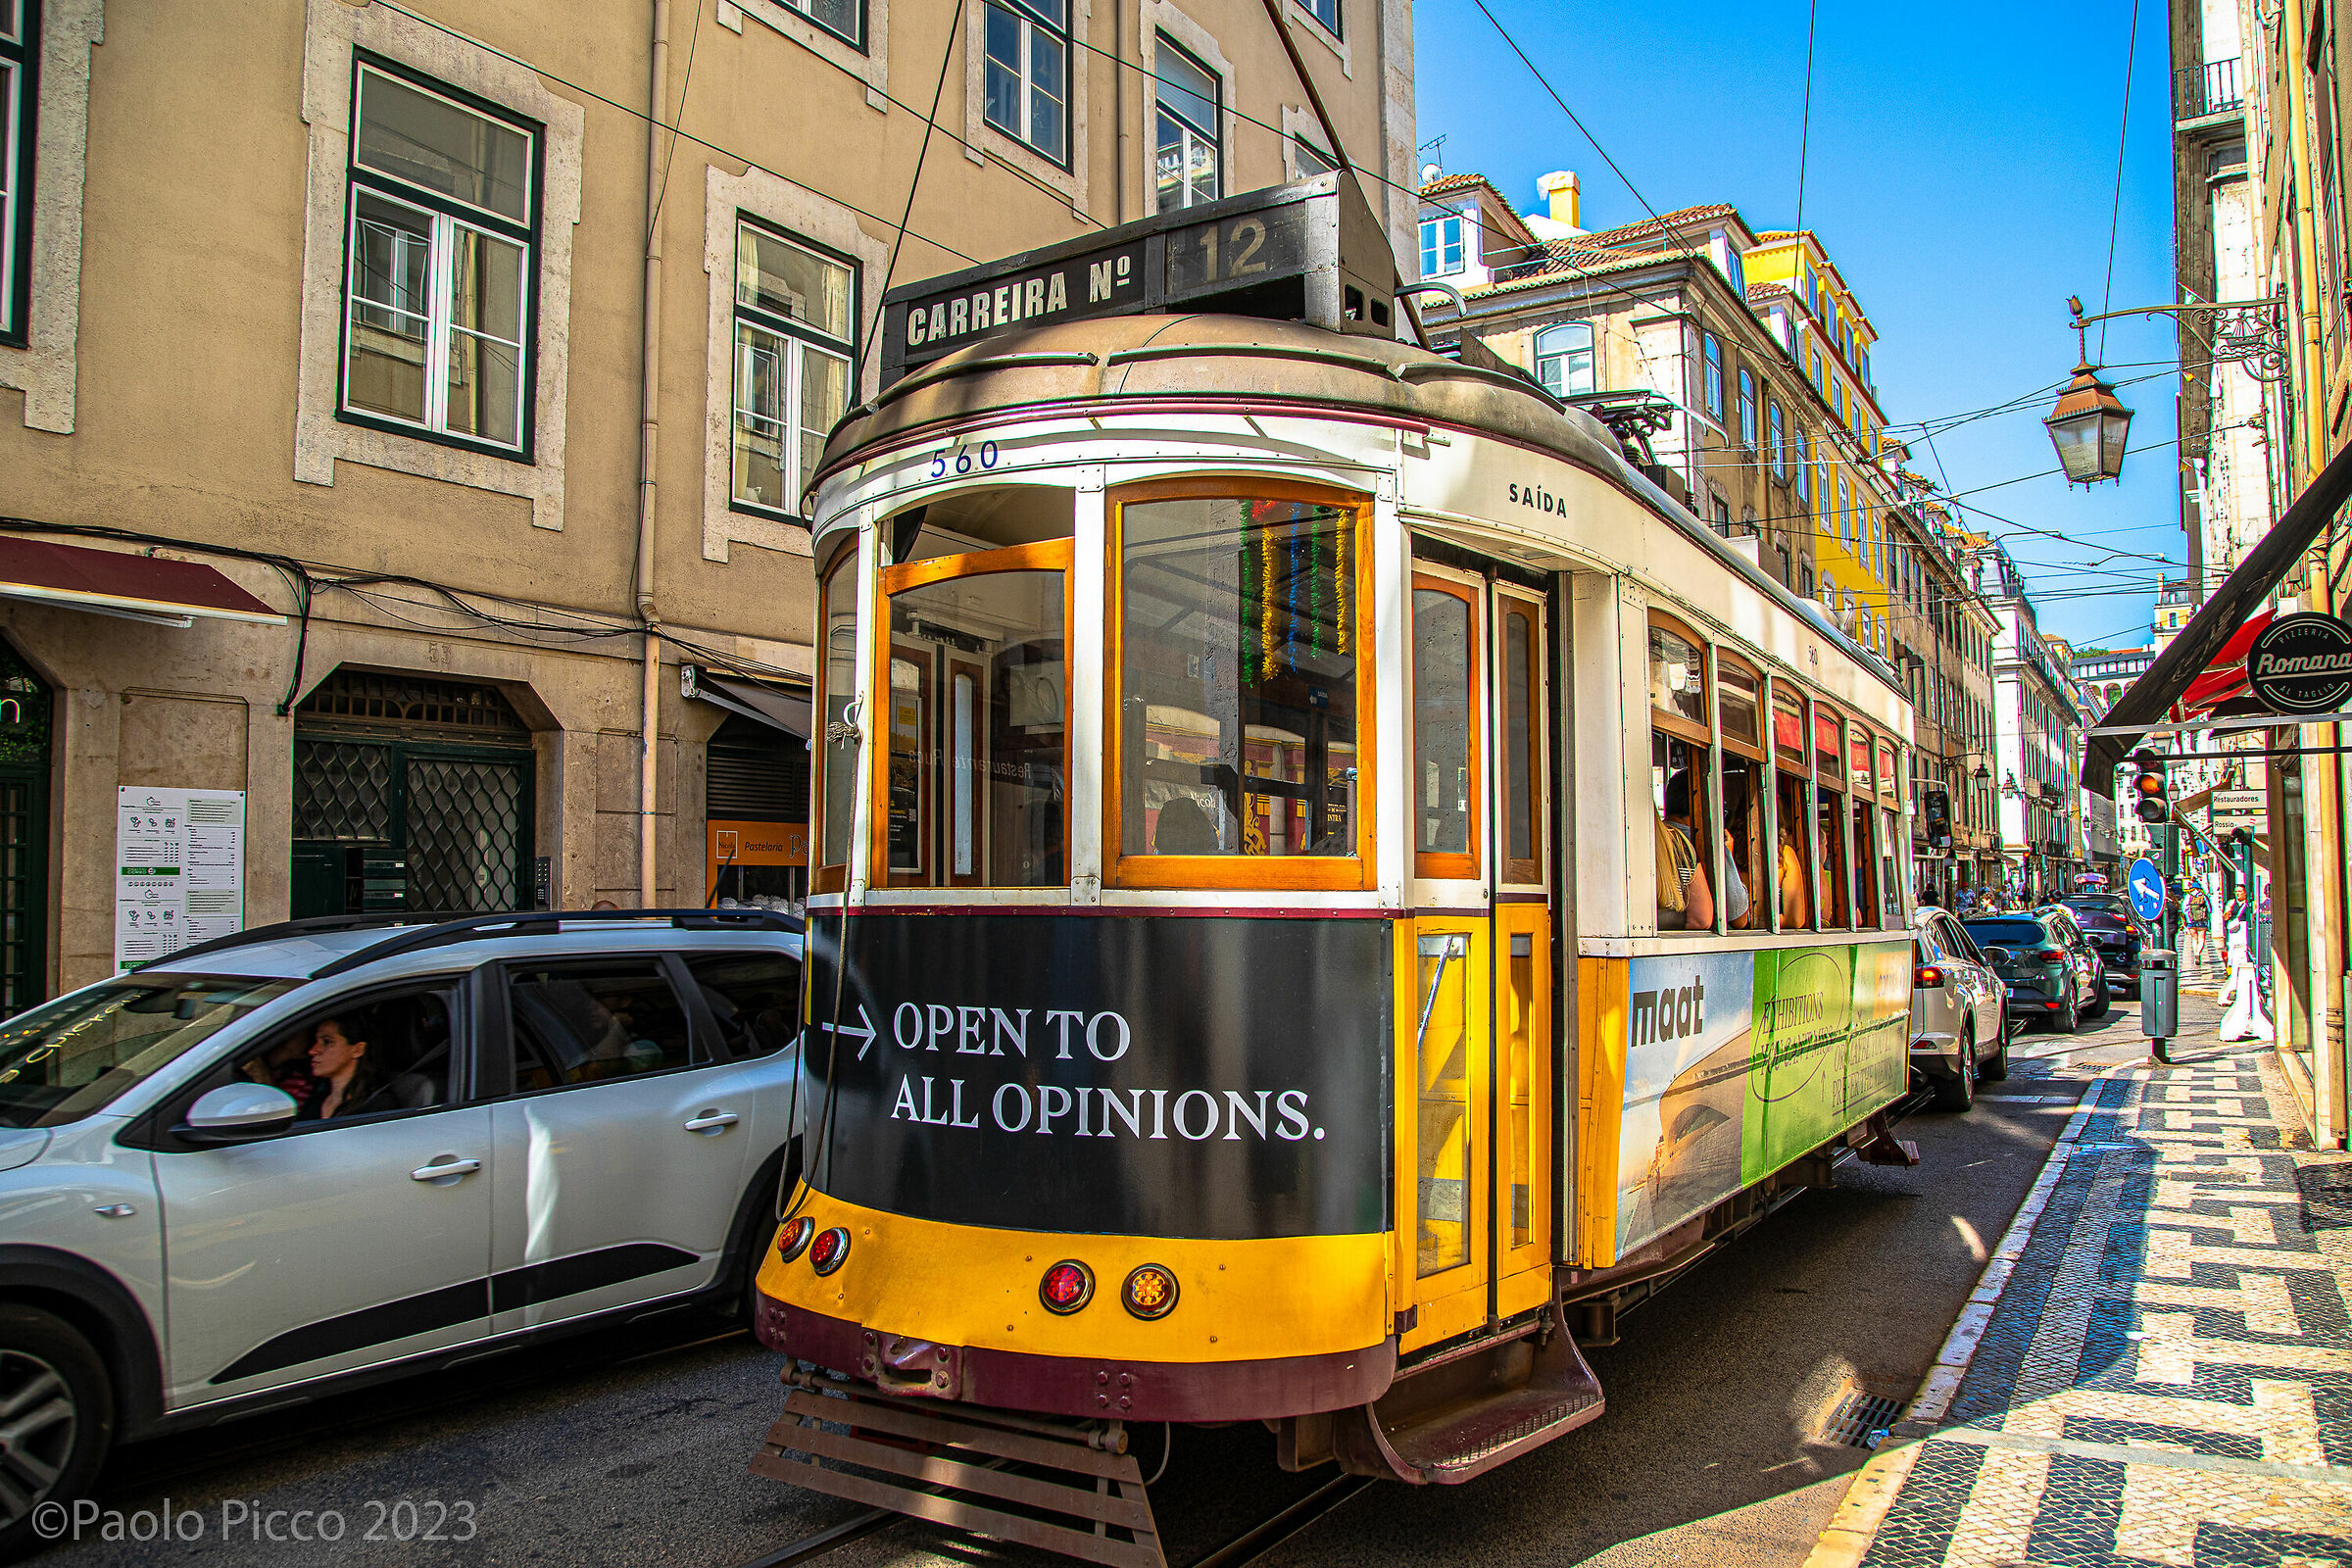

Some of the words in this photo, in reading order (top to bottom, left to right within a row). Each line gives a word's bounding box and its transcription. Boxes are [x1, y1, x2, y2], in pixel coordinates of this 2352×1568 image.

[1199, 217, 1267, 283] 12
[906, 270, 1067, 347] CARREIRA
[1088, 255, 1132, 304] Nº
[930, 440, 999, 479] 560
[1508, 482, 1568, 518] SAÍDA
[428, 642, 452, 665] 53
[2278, 628, 2329, 644] PIZZERIA
[2256, 652, 2352, 675] Romana
[2279, 685, 2291, 696] AL
[2297, 683, 2334, 698] TAGLIO
[744, 840, 783, 852] Pastelaria
[1631, 974, 1704, 1048] maat
[1762, 991, 1824, 1035] EXHIBITIONS
[893, 1002, 1032, 1057] OPEN
[1045, 1008, 1131, 1061] TO
[890, 1073, 980, 1128] ALL
[992, 1083, 1326, 1142] OPINIONS.
